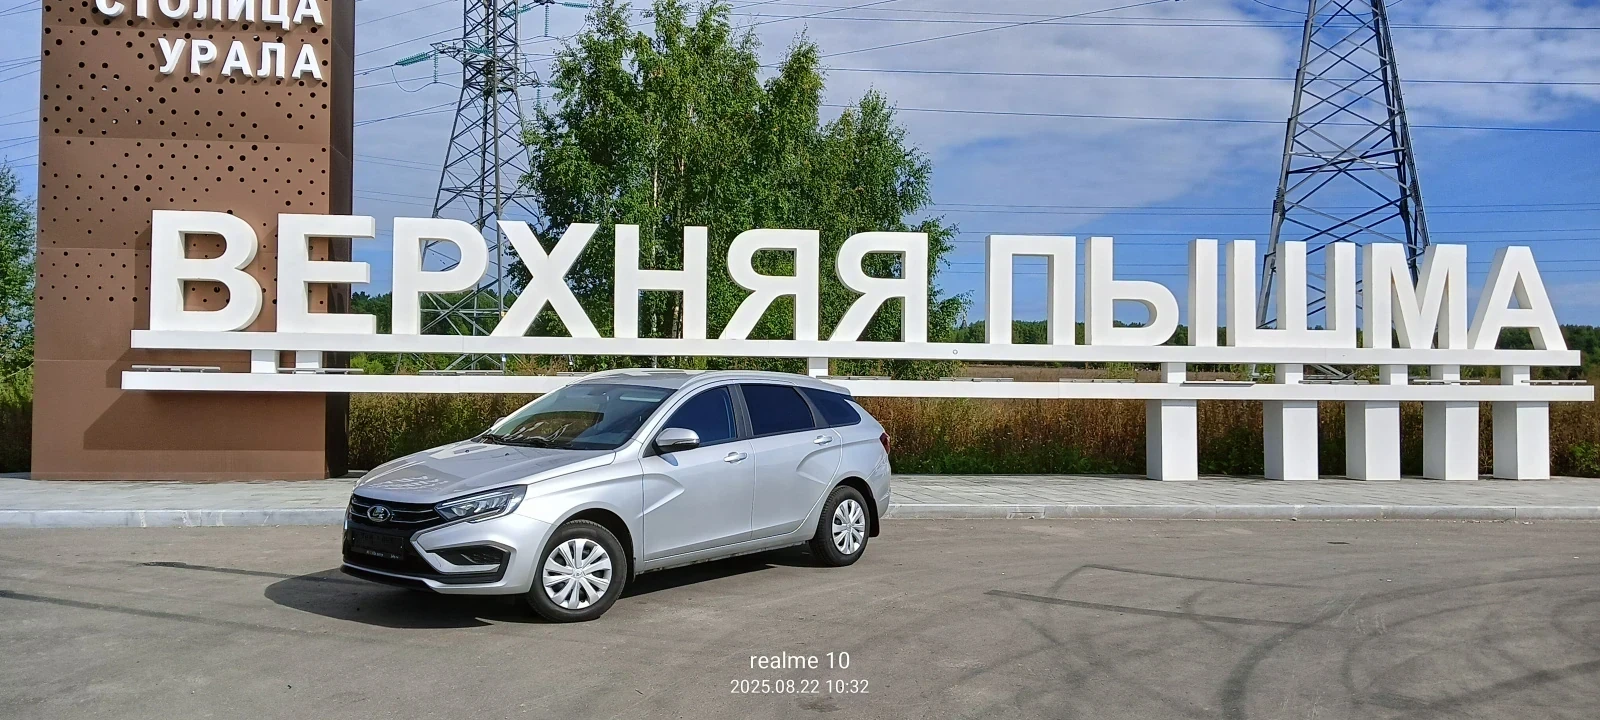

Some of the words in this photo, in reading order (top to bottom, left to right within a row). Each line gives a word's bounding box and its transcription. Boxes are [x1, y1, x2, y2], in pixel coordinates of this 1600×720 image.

[157, 38, 323, 80] УРАЛА
[150, 209, 929, 343] ВЕРХНЯЯ
[985, 234, 1567, 351] ПЫШМА
